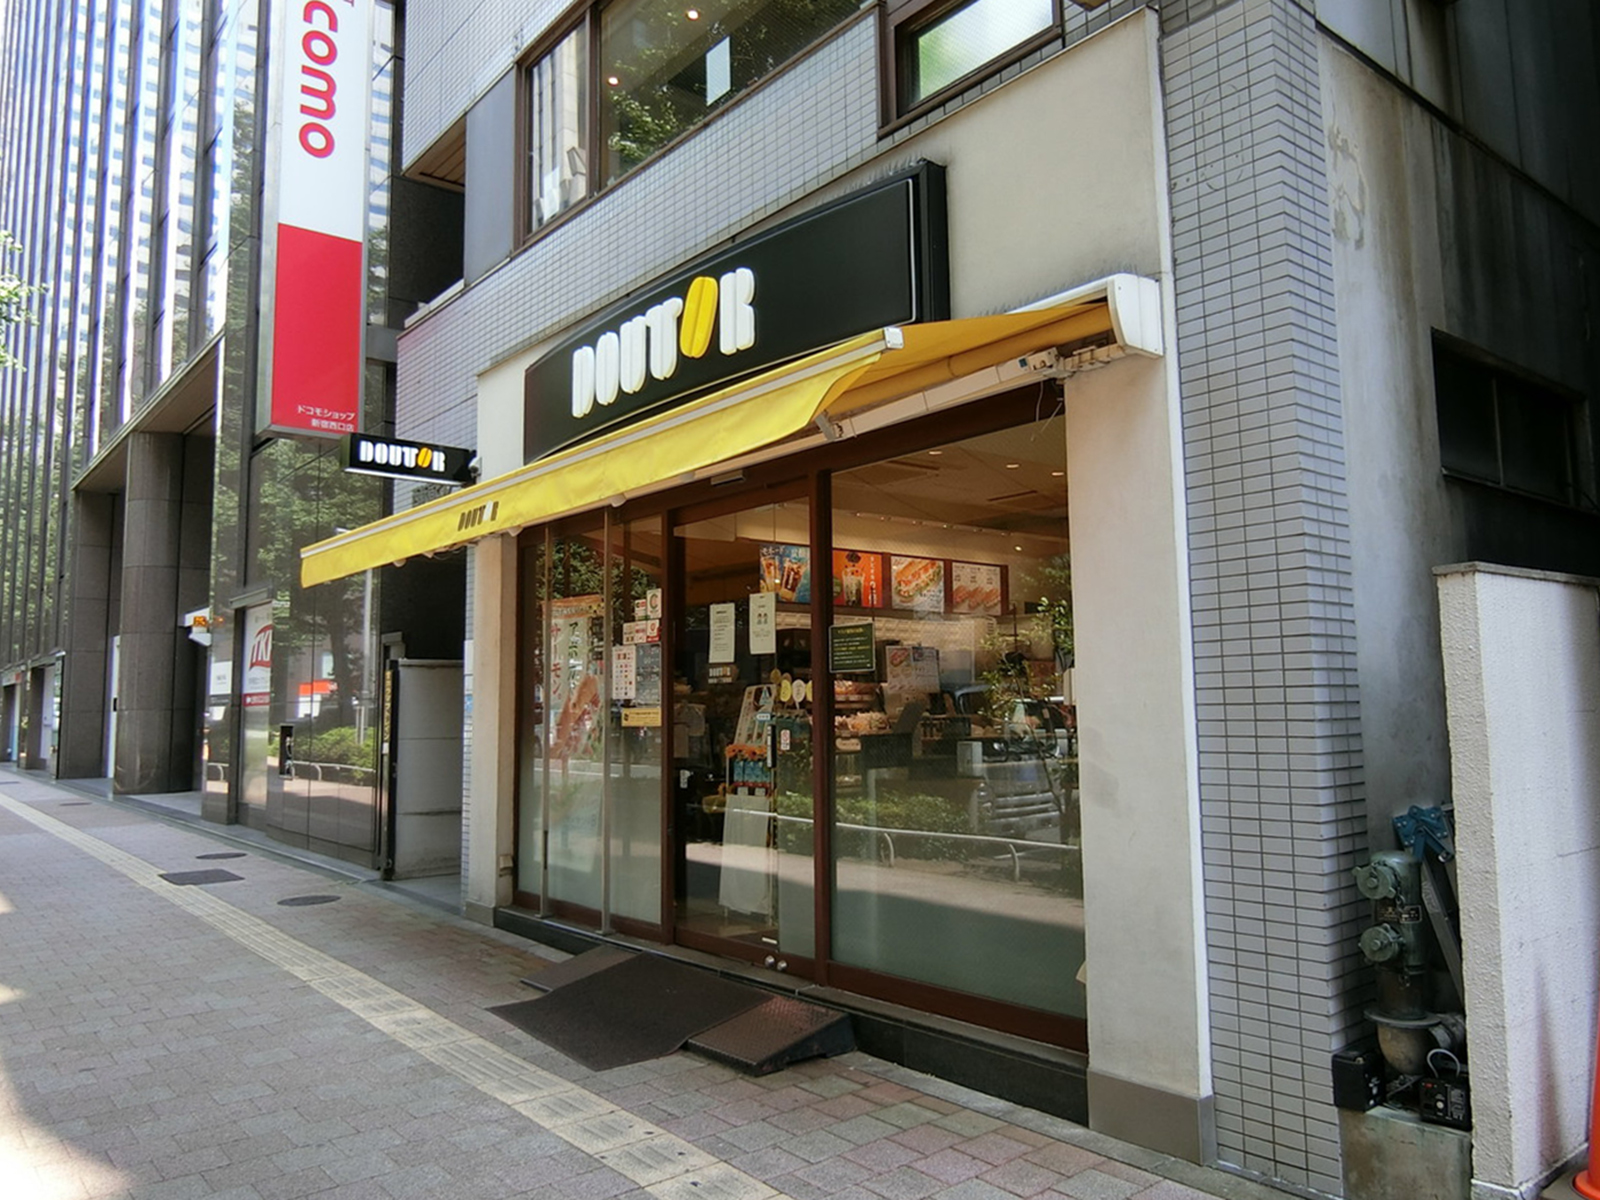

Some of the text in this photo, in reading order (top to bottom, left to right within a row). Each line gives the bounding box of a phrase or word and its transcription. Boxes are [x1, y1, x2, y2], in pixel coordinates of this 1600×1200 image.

[572, 267, 755, 418] DOUTOR
[298, 405, 356, 420] ドコモショップ
[359, 440, 445, 472] DOUTOR
